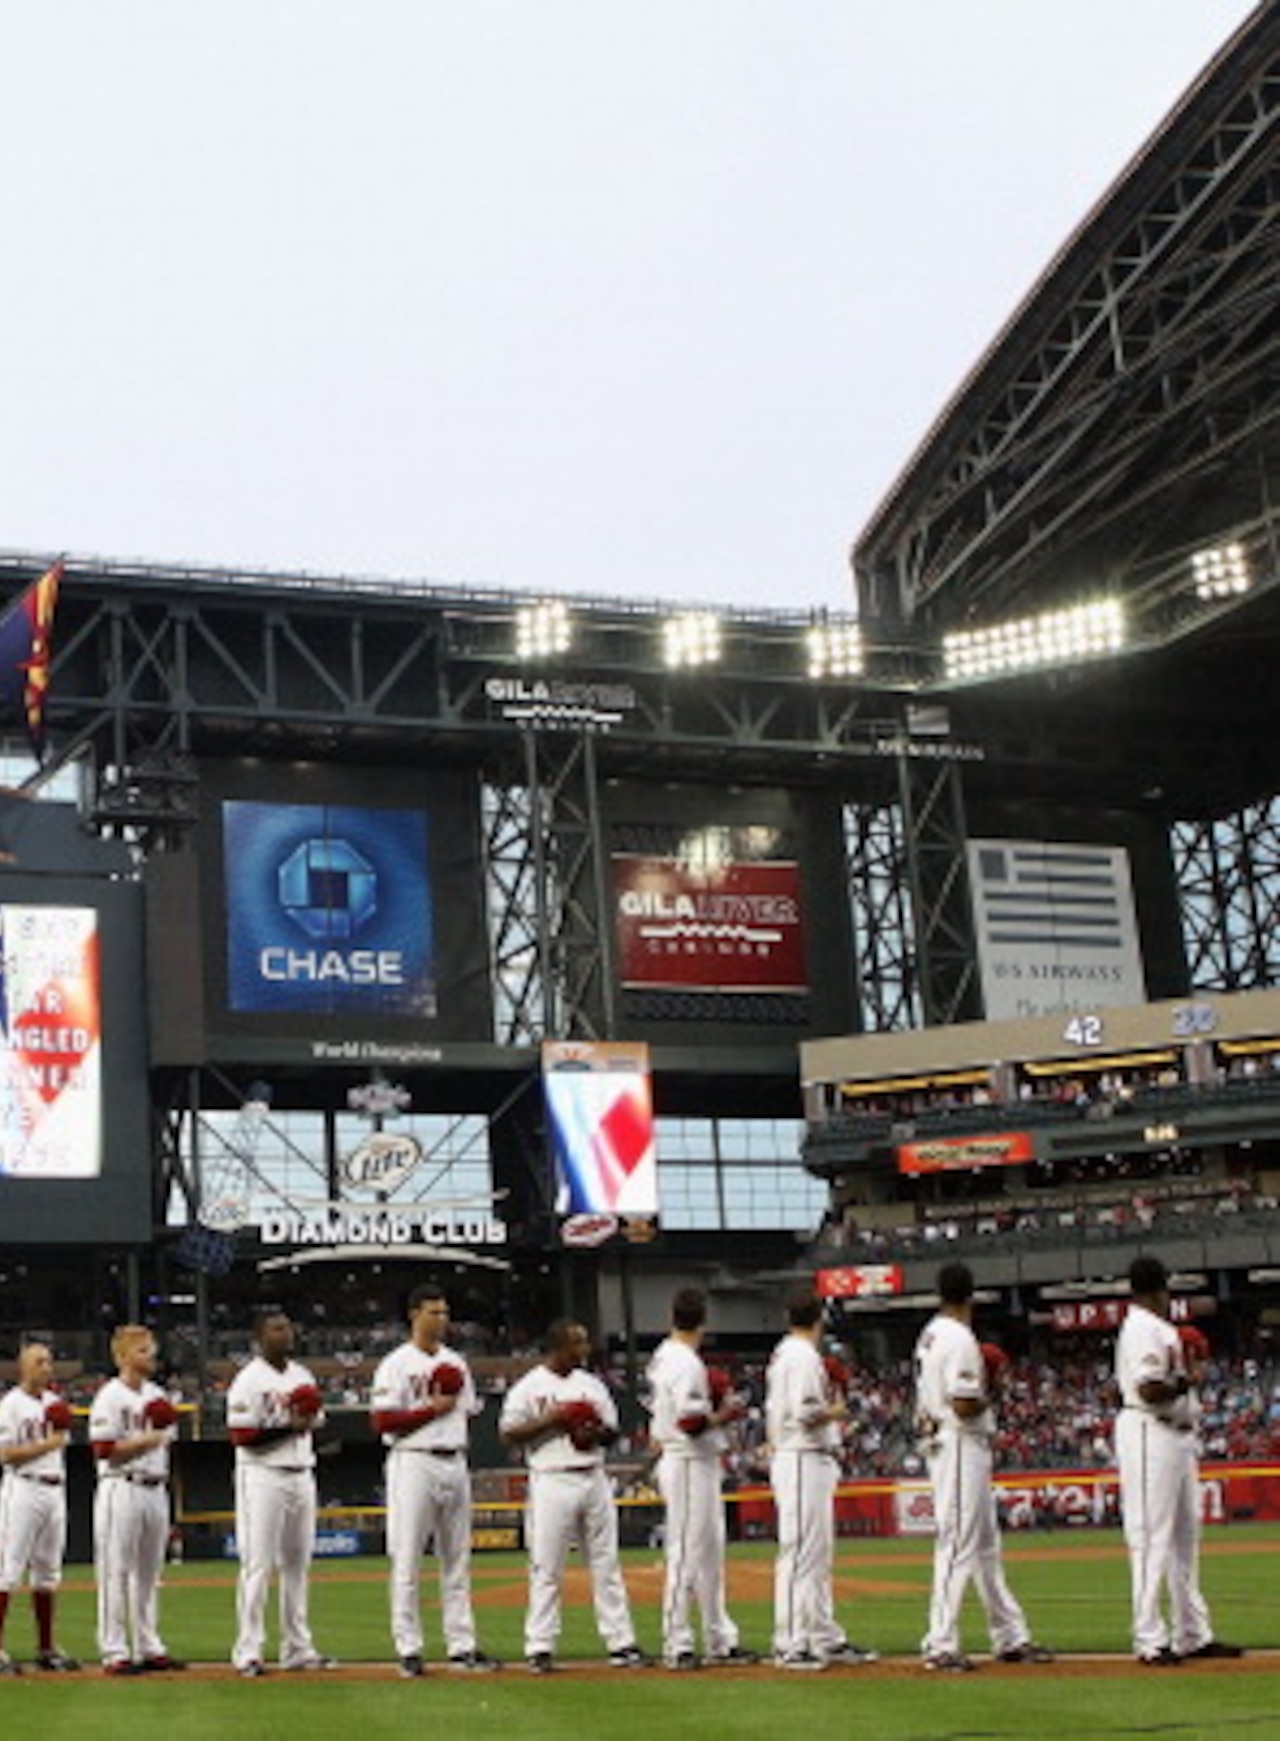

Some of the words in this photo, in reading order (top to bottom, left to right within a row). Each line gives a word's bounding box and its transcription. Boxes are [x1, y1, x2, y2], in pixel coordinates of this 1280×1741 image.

[485, 679, 549, 700] GILA
[619, 891, 695, 920] GILA
[260, 947, 403, 985] CHASE
[1063, 1015, 1102, 1045] 42
[261, 1212, 412, 1244] DIAMOND
[421, 1218, 508, 1244] CLUB
